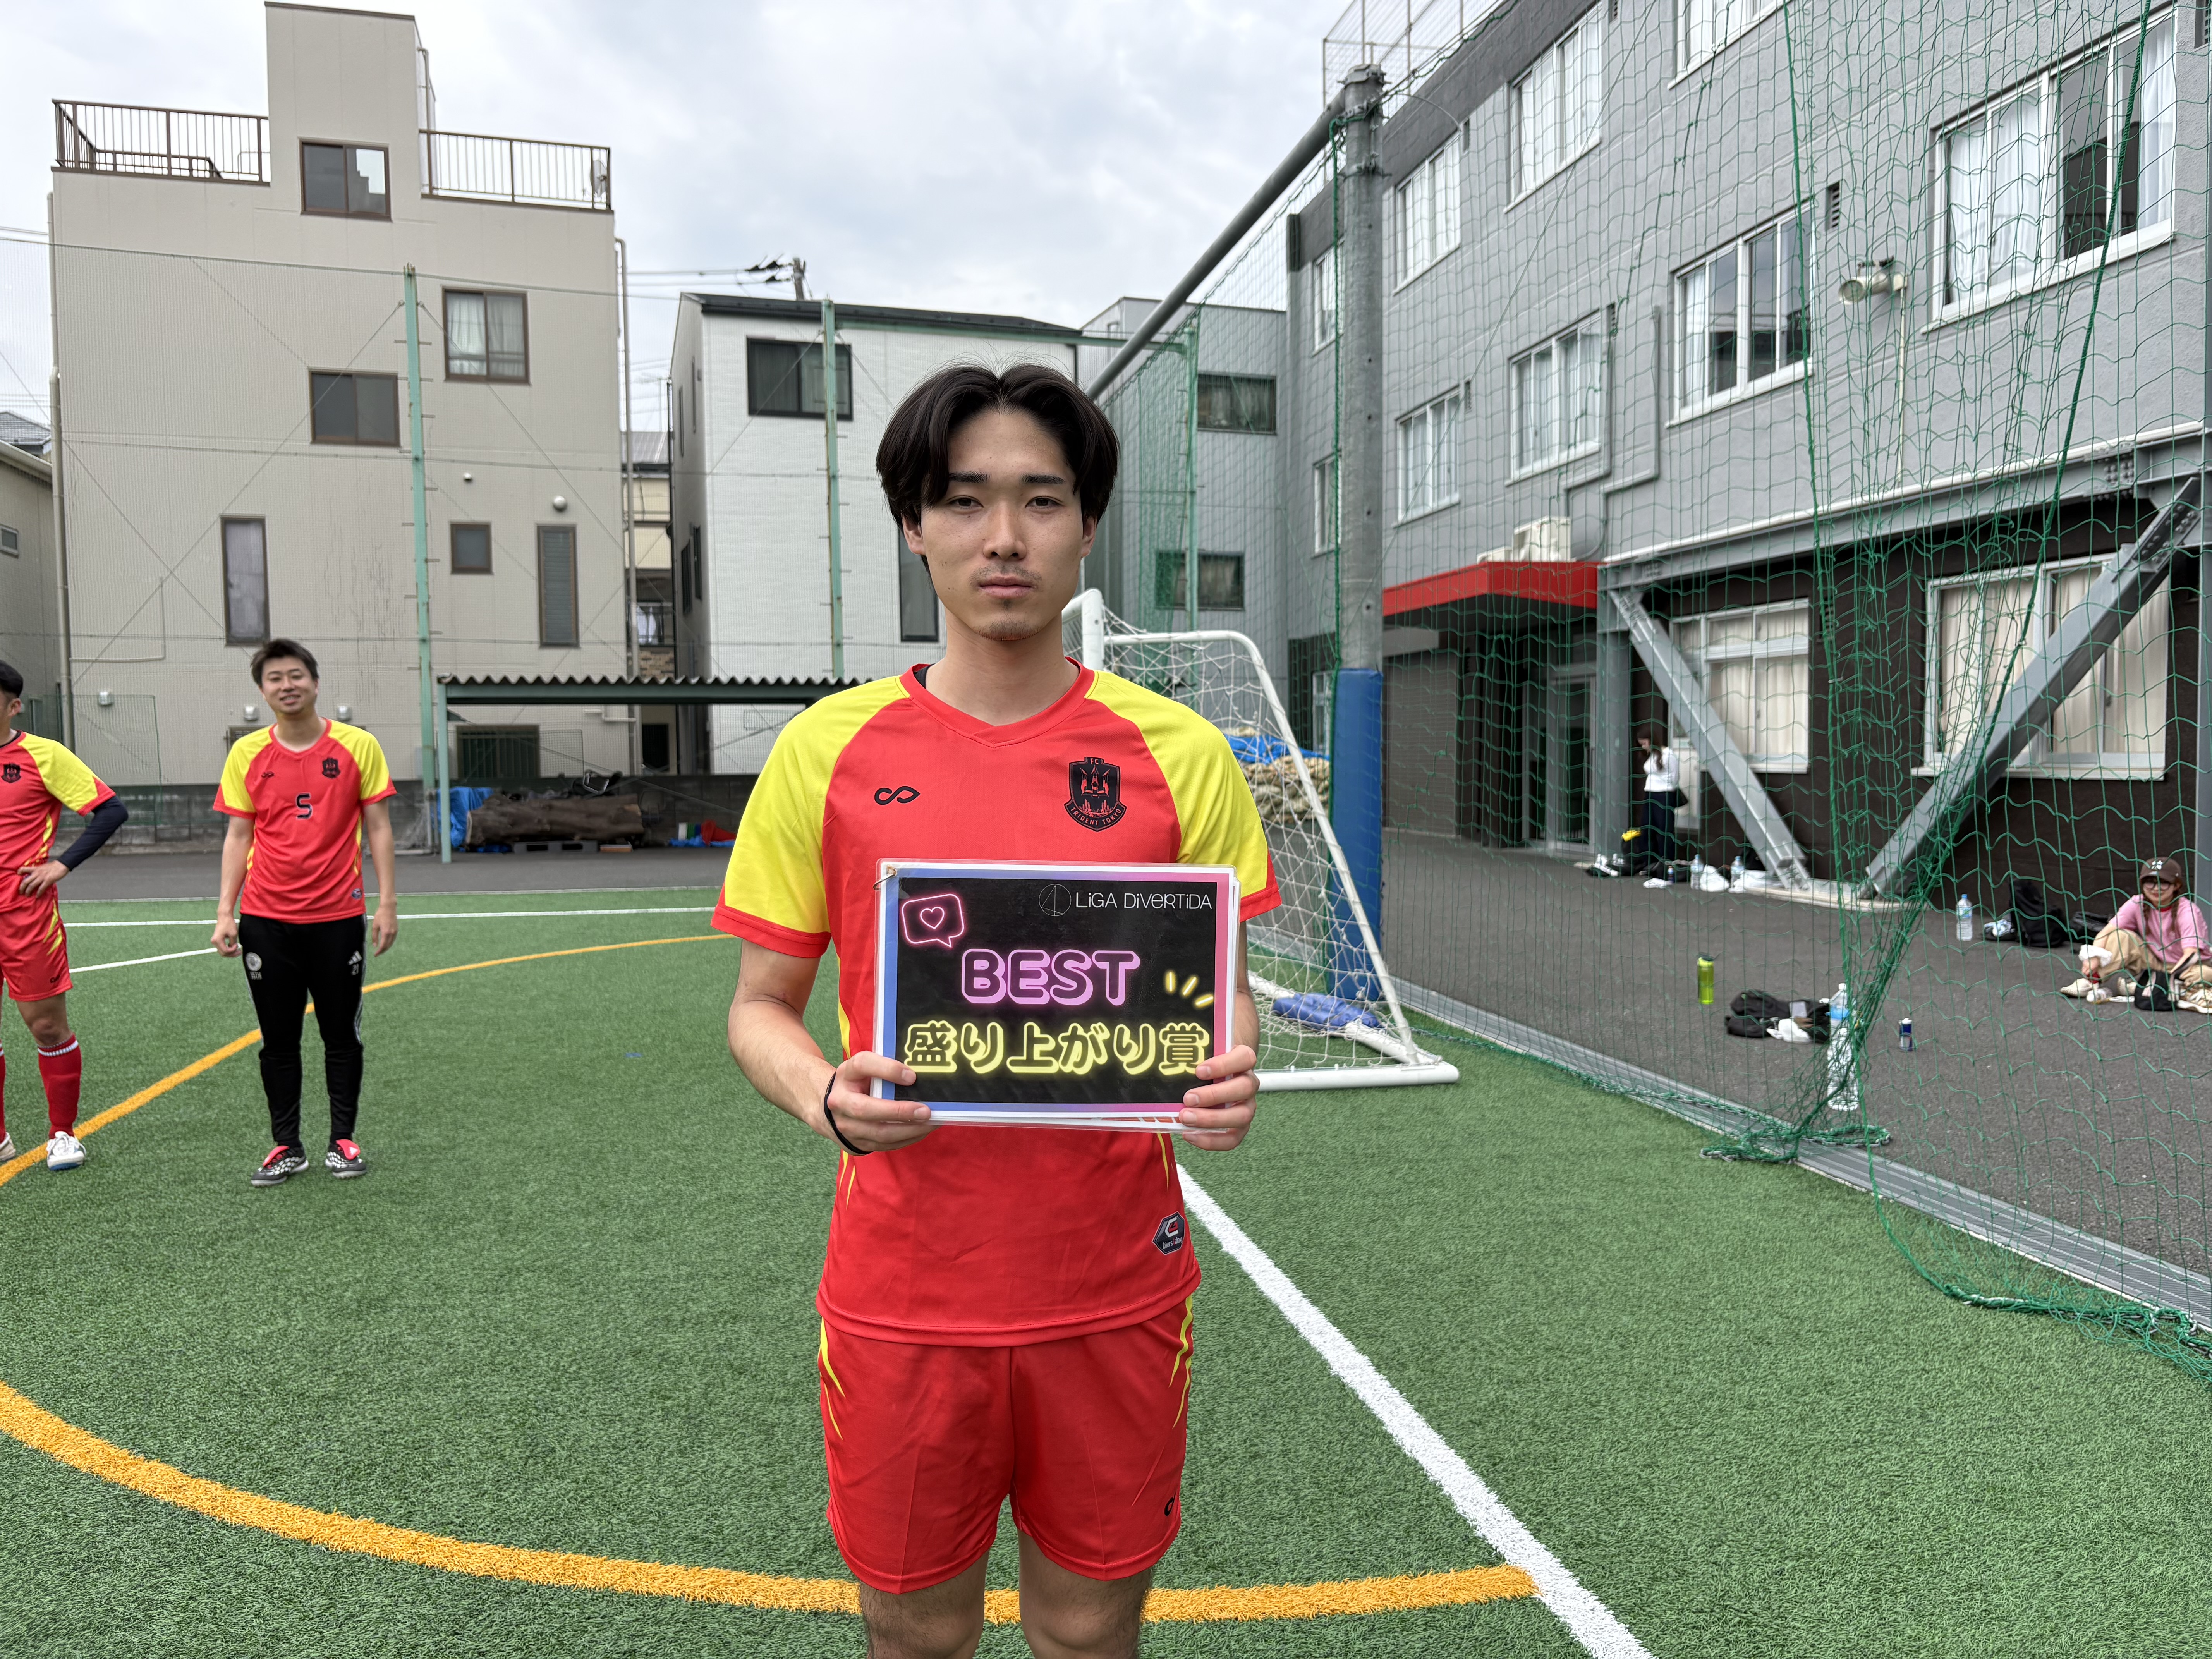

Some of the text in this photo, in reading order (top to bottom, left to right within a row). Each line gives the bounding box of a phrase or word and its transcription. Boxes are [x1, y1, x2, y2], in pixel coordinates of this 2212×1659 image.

[296, 792, 313, 819] 5
[1070, 807, 1121, 826] TRIDENT TOKYO
[962, 948, 1140, 1006] BEST
[904, 1020, 1210, 1075] 盛り上がり賞
